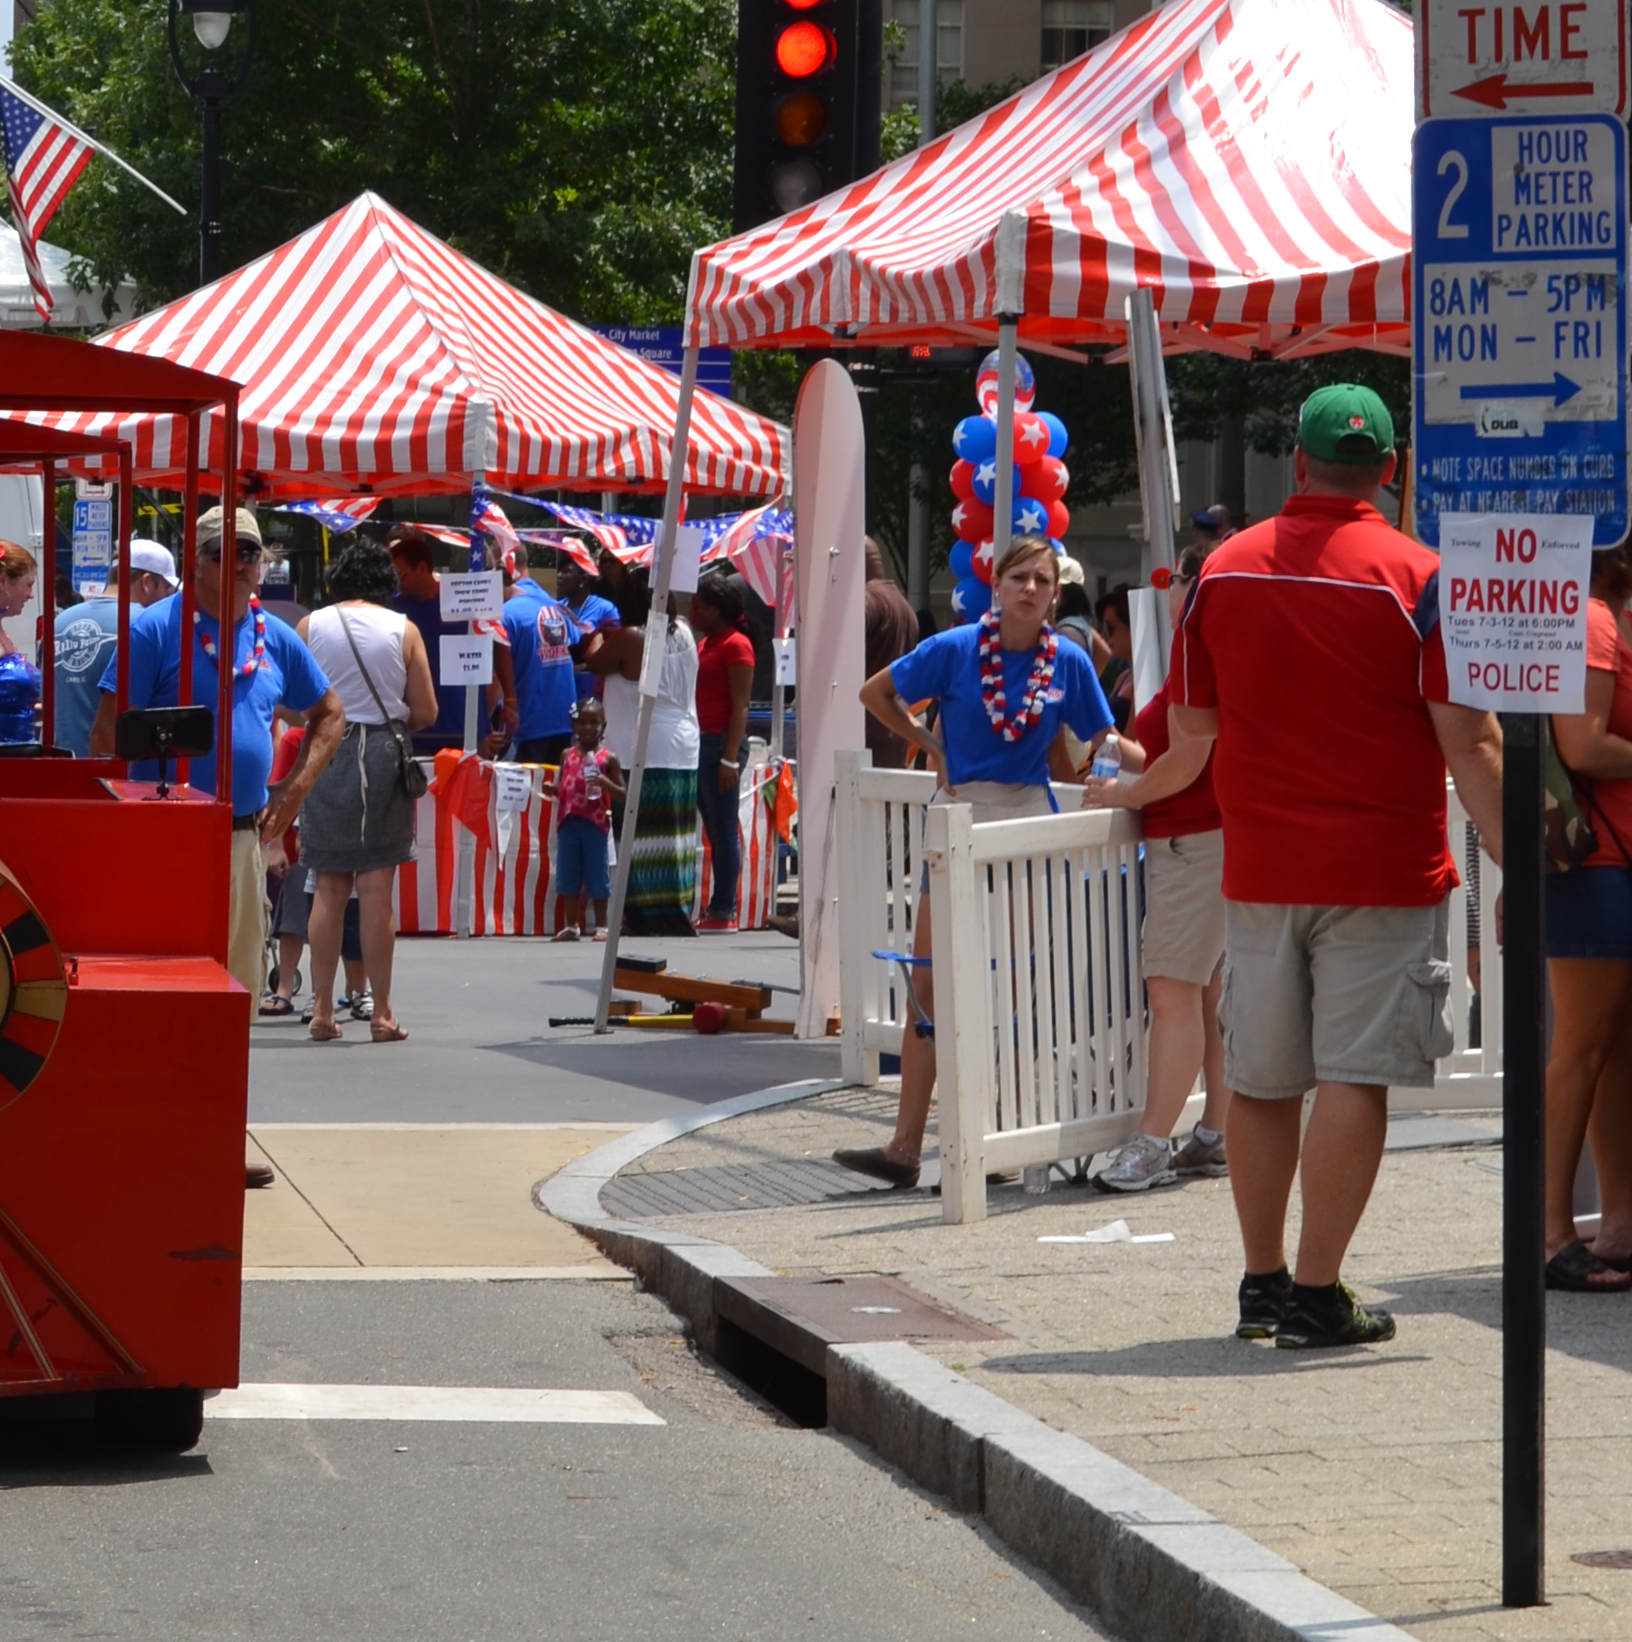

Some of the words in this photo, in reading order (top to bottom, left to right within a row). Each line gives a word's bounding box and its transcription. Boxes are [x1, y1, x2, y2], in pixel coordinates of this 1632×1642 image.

[1457, 3, 1589, 64] TIME
[1518, 129, 1588, 165] HOUR
[1436, 149, 1469, 239] 2
[1514, 170, 1593, 206] METER
[1497, 210, 1612, 248] PARKING
[1429, 276, 1490, 317] 8AM
[1546, 273, 1606, 313] 5PM
[609, 329, 626, 342] City
[629, 330, 660, 341] Market
[1434, 323, 1497, 363] MON
[1554, 320, 1602, 359] FRI
[640, 348, 672, 360] Square
[1432, 457, 1461, 482] NOTE
[1466, 456, 1504, 481] SPACE
[1509, 455, 1556, 480] NUMBER
[1561, 454, 1578, 479] ON
[1583, 454, 1615, 478] CURB
[76, 506, 87, 527] 15
[1433, 491, 1454, 516] PAY
[1459, 491, 1472, 512] AT
[1477, 490, 1531, 513] NEAREST
[1536, 489, 1559, 514] PAY
[1565, 488, 1615, 514] STATION
[1451, 538, 1481, 549] Towing
[1495, 528, 1537, 564] NO
[1450, 577, 1579, 615] PARKING
[1448, 616, 1475, 627] Tues
[1479, 616, 1514, 628] 7-3-12
[1518, 618, 1529, 628] at
[1532, 618, 1575, 629] 6:00PM
[1449, 636, 1480, 649] Thurs
[1484, 638, 1519, 650] 7-5-12
[1523, 639, 1534, 650] at
[1537, 639, 1562, 651] 2:00
[1565, 640, 1583, 651] AM
[1468, 661, 1560, 692] POLICE
